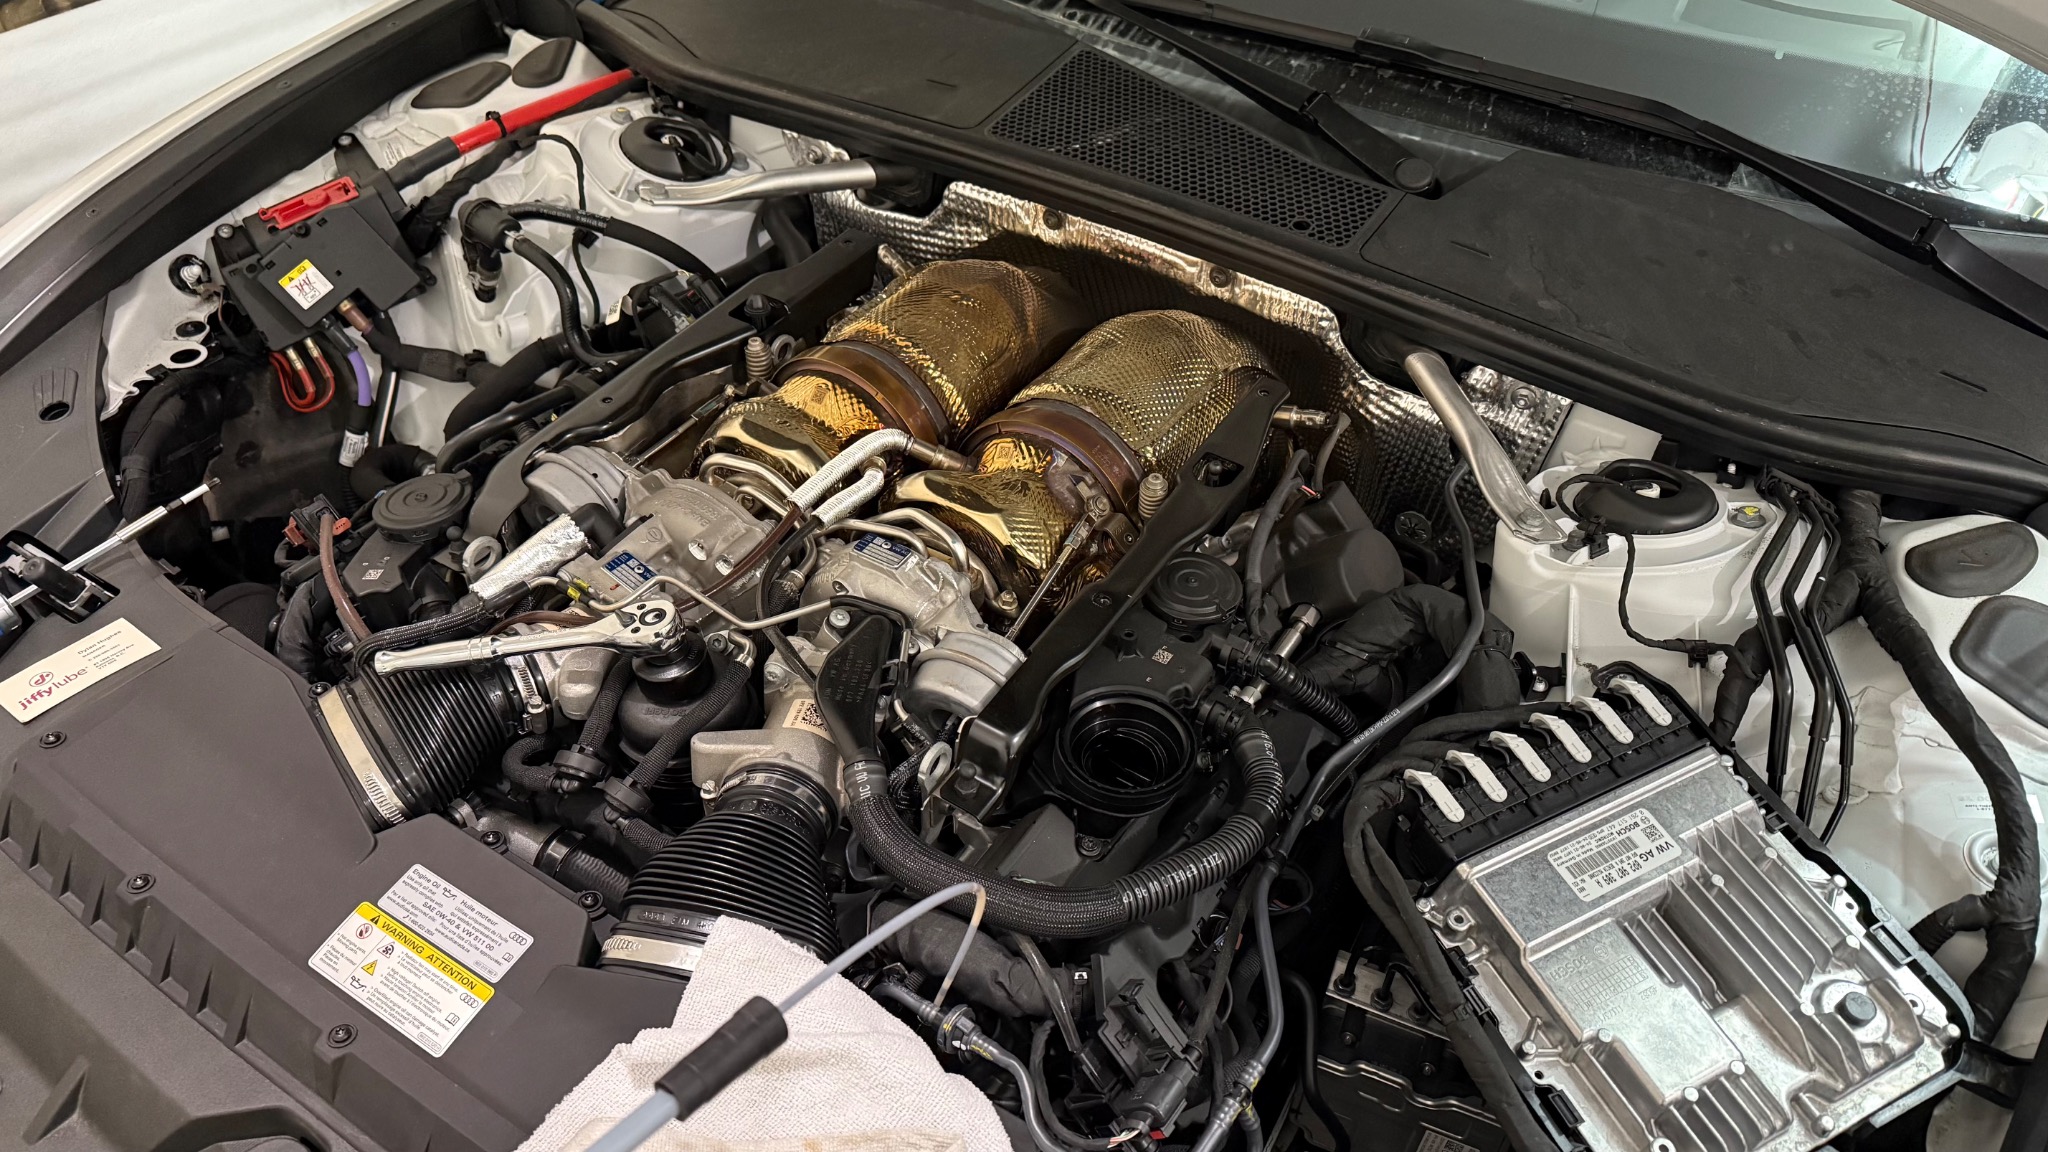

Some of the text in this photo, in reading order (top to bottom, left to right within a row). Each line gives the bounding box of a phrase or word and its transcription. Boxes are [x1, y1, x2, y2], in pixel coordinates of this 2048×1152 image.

[77, 643, 97, 655] Dylan
[18, 668, 88, 710] jiffy lube
[1627, 811, 1639, 820] 261
[1604, 823, 1616, 831] 447
[1614, 820, 1640, 836] BOSCH
[1593, 831, 1614, 843] MOTRONIC
[1653, 839, 1674, 854] VW
[1555, 855, 1576, 867] Germany
[1637, 848, 1656, 862] AG
[411, 868, 441, 889] Engine Oil
[1600, 871, 1617, 885] 309
[1613, 865, 1630, 879] 907
[1593, 878, 1604, 888] A
[459, 899, 498, 927] Huile moteur
[421, 901, 436, 912] SAE
[434, 909, 456, 925] 0W-40
[460, 927, 474, 938] VW
[472, 934, 486, 945] 511
[484, 942, 495, 951] 00
[380, 921, 425, 954] WARNING
[425, 952, 477, 990] ATTENTION
